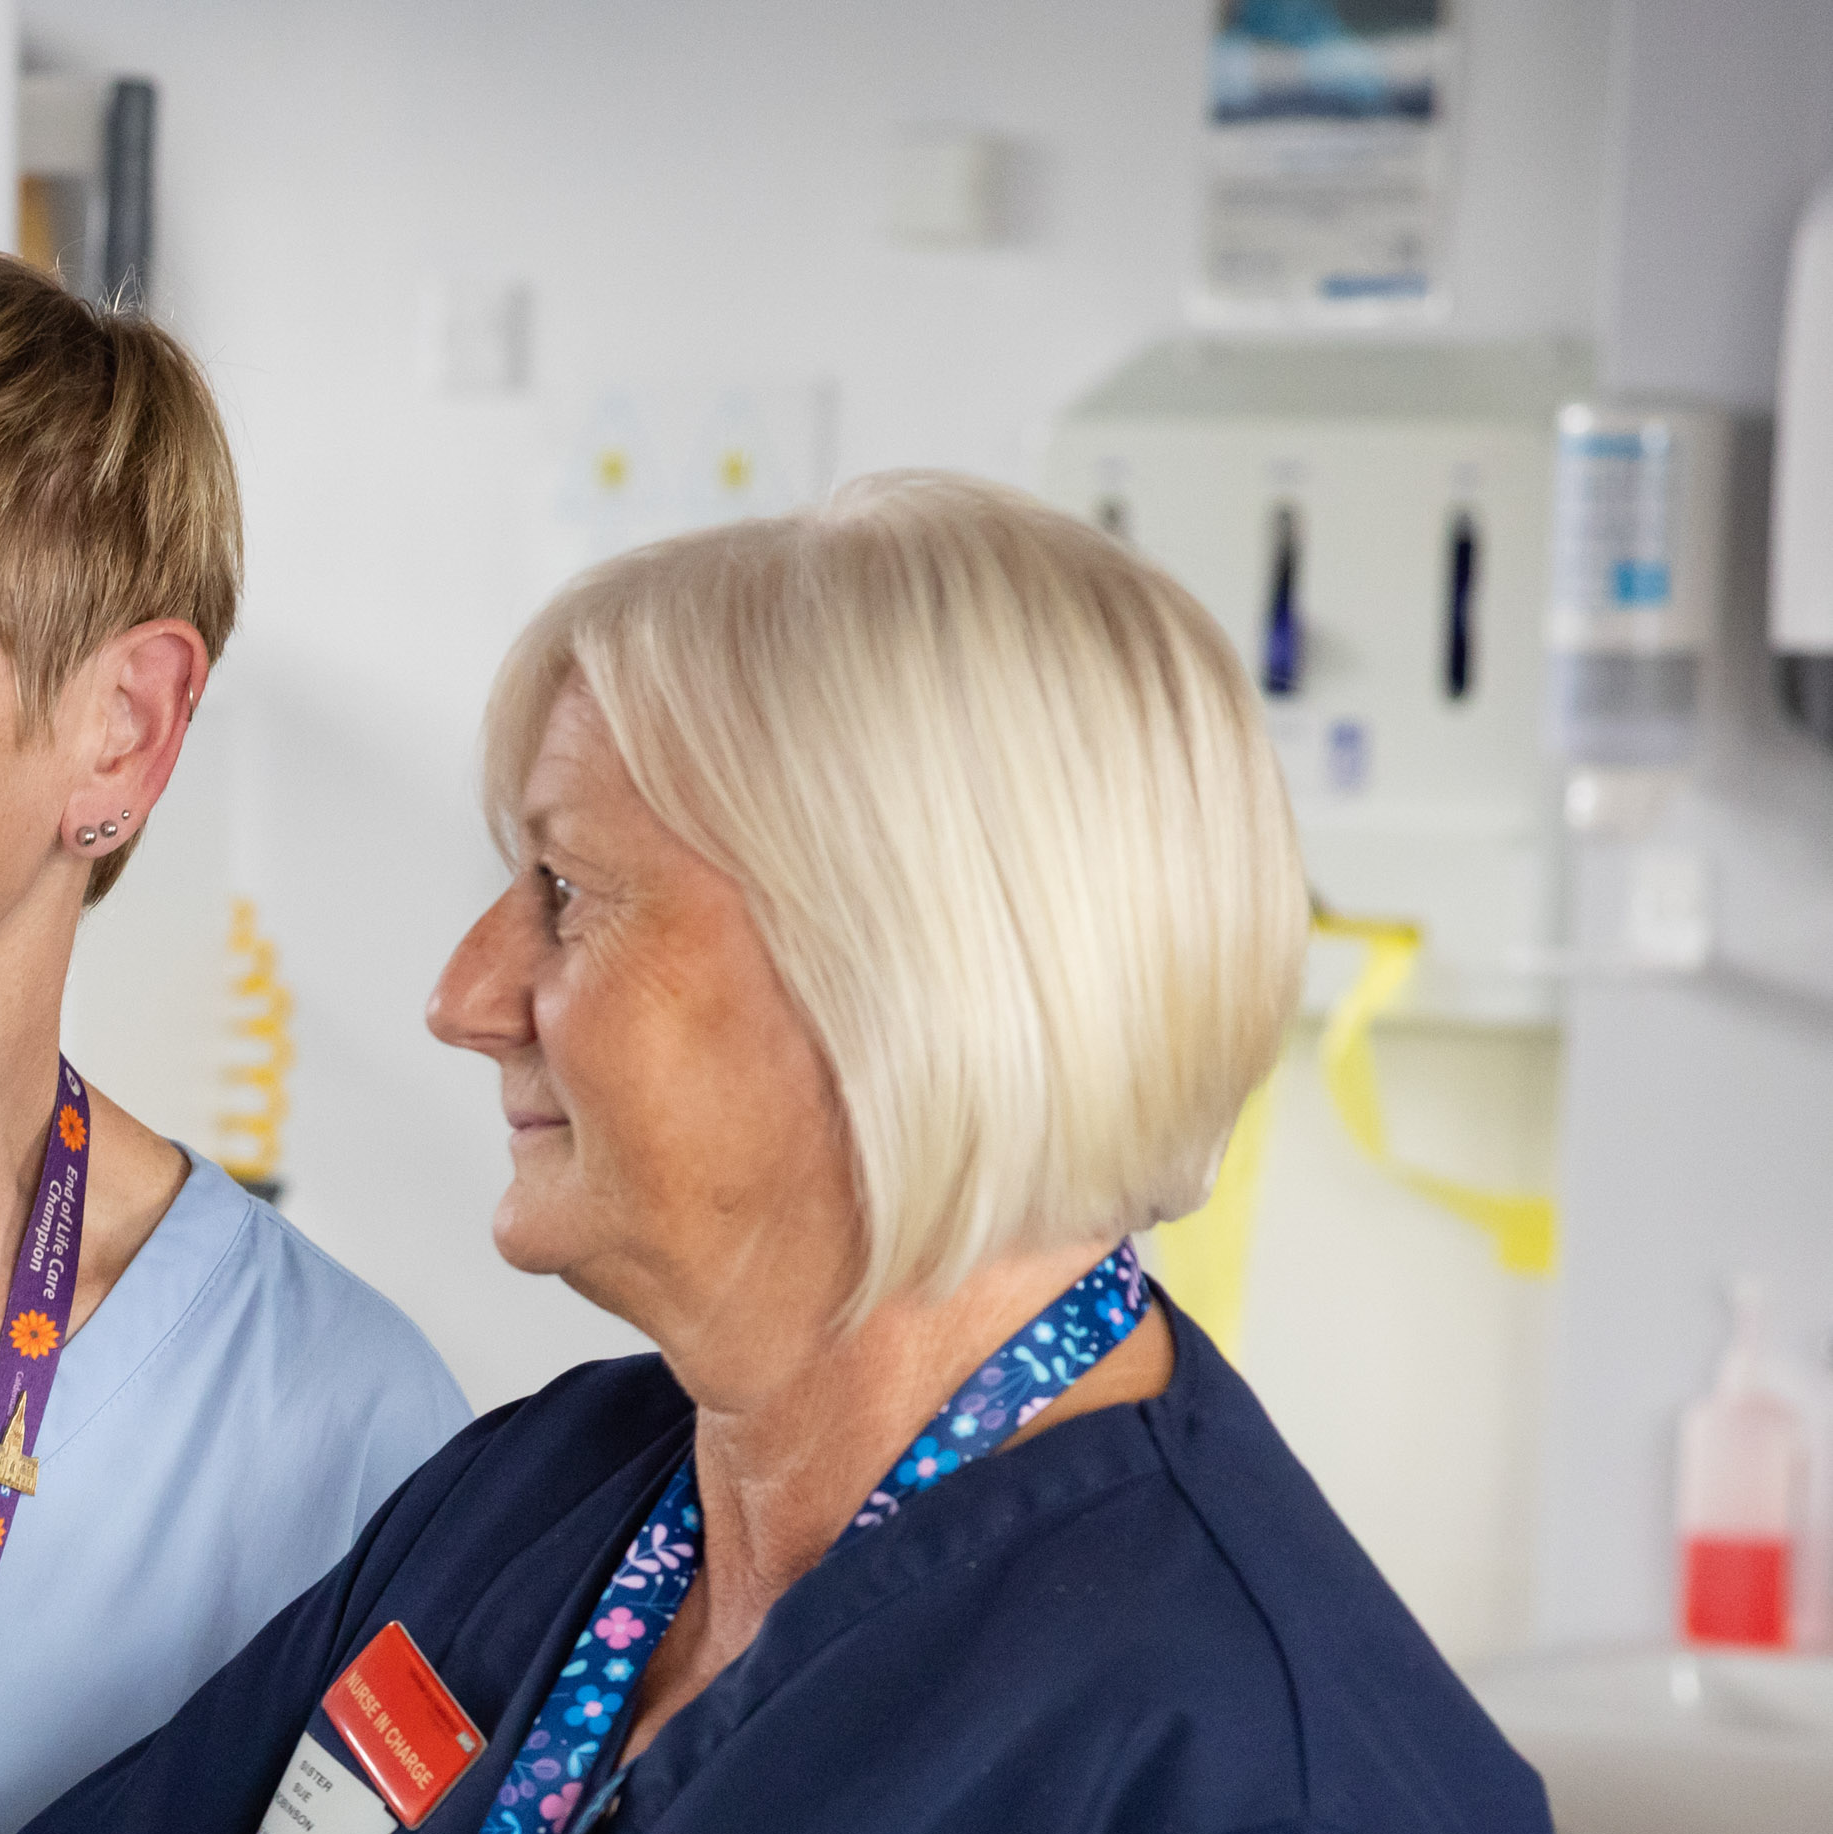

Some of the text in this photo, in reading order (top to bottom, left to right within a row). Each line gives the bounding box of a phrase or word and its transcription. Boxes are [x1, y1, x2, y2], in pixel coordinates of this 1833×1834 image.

[29, 1180, 62, 1273] Champion
[43, 1164, 78, 1301] End of Life Care
[299, 1760, 333, 1793] SISTER
[345, 1670, 435, 1791] NURSE IN CHARGE
[292, 1782, 313, 1803] SUE
